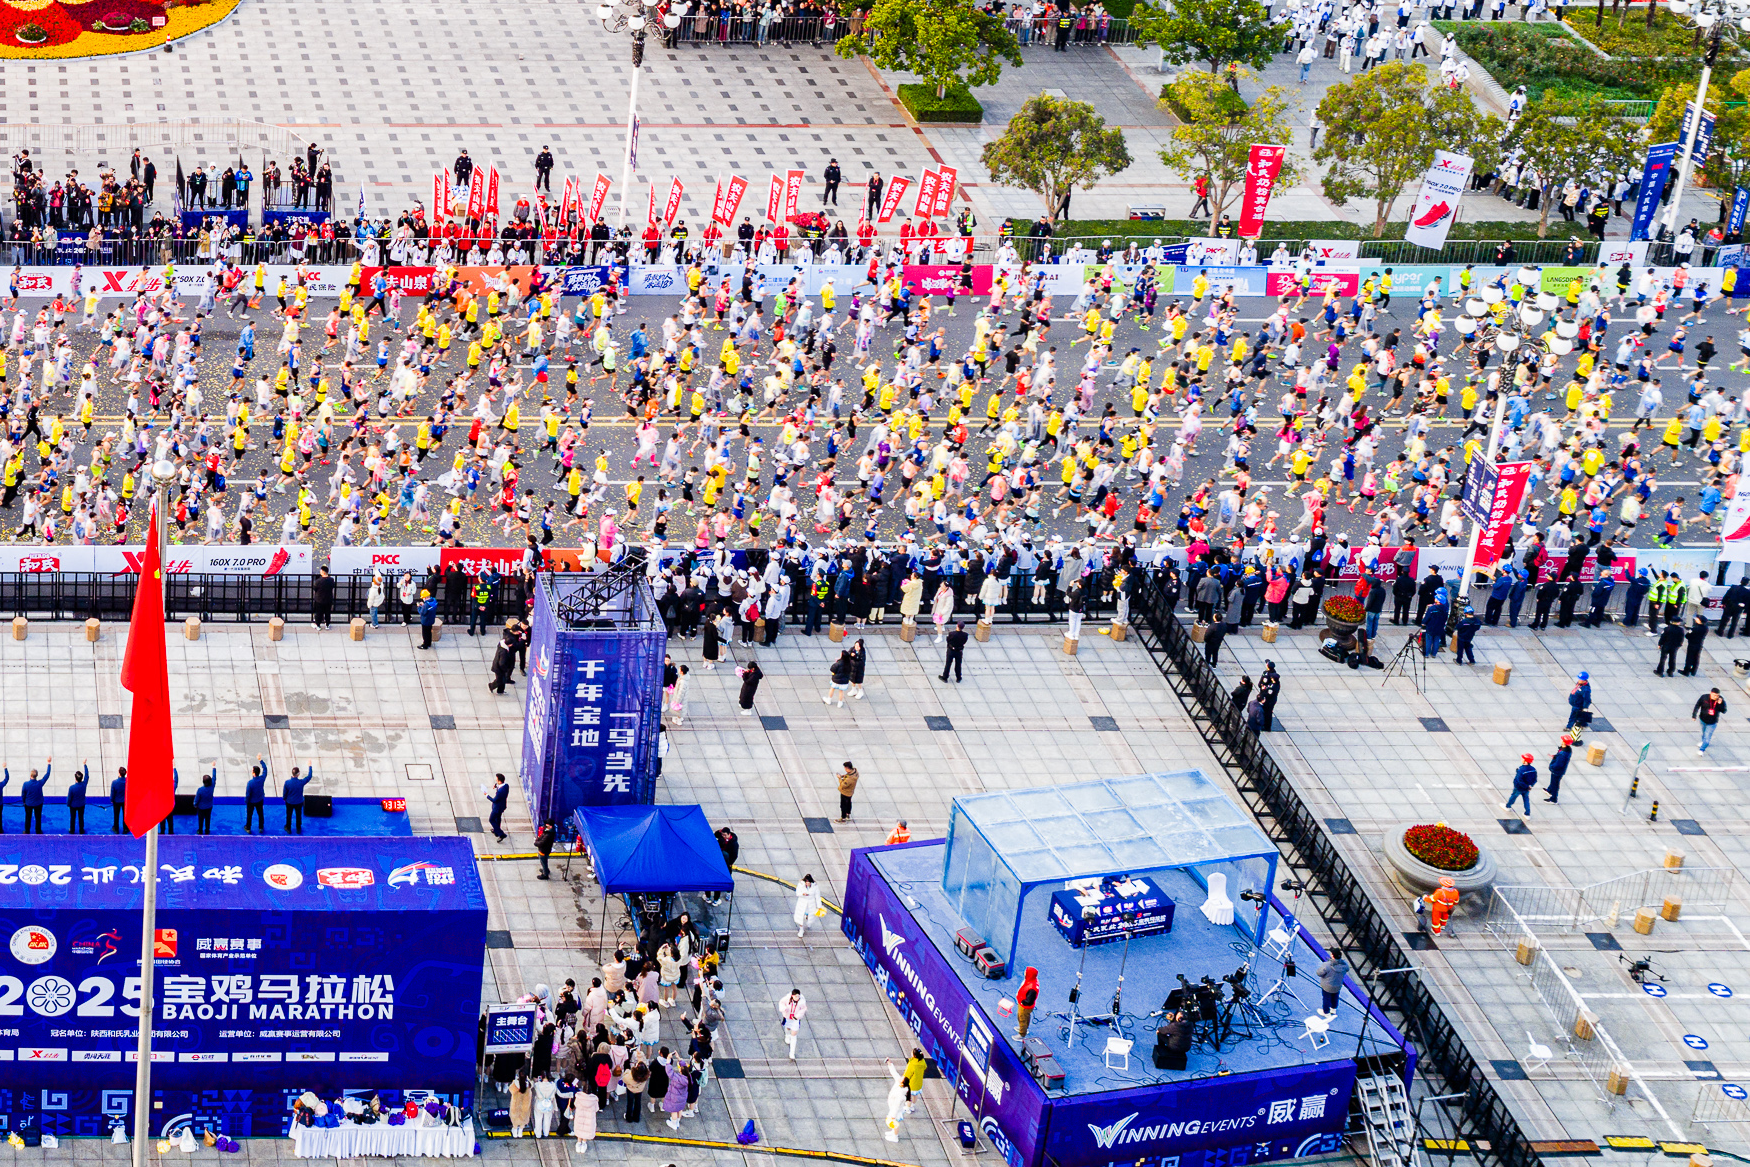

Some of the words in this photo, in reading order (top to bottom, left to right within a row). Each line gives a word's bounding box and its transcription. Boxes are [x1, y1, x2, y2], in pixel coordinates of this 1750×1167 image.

[471, 174, 481, 214] 农夫山泉
[591, 182, 606, 221] 农夫山泉
[724, 183, 741, 221] 农夫山泉
[786, 176, 801, 217] 农夫山泉
[883, 182, 904, 218] 农夫山泉
[919, 175, 936, 214] 农夫山泉
[935, 171, 954, 212] 农夫山泉
[21, 276, 51, 290] 和氏
[21, 557, 60, 573] 和氏
[209, 558, 233, 567] 160X
[234, 558, 247, 567] 7.0
[248, 558, 267, 567] PRO
[372, 554, 400, 565] PICC
[571, 660, 605, 747] 千年宝地
[603, 712, 638, 793] 一马当先
[196, 938, 262, 951] 威赢赛事
[163, 975, 394, 1004] 宝鸡马拉松
[163, 1004, 238, 1020] BAOJI
[249, 1004, 394, 1020] MARATHON
[496, 1016, 528, 1026] 主舞台
[1267, 1095, 1328, 1126] 威赢
